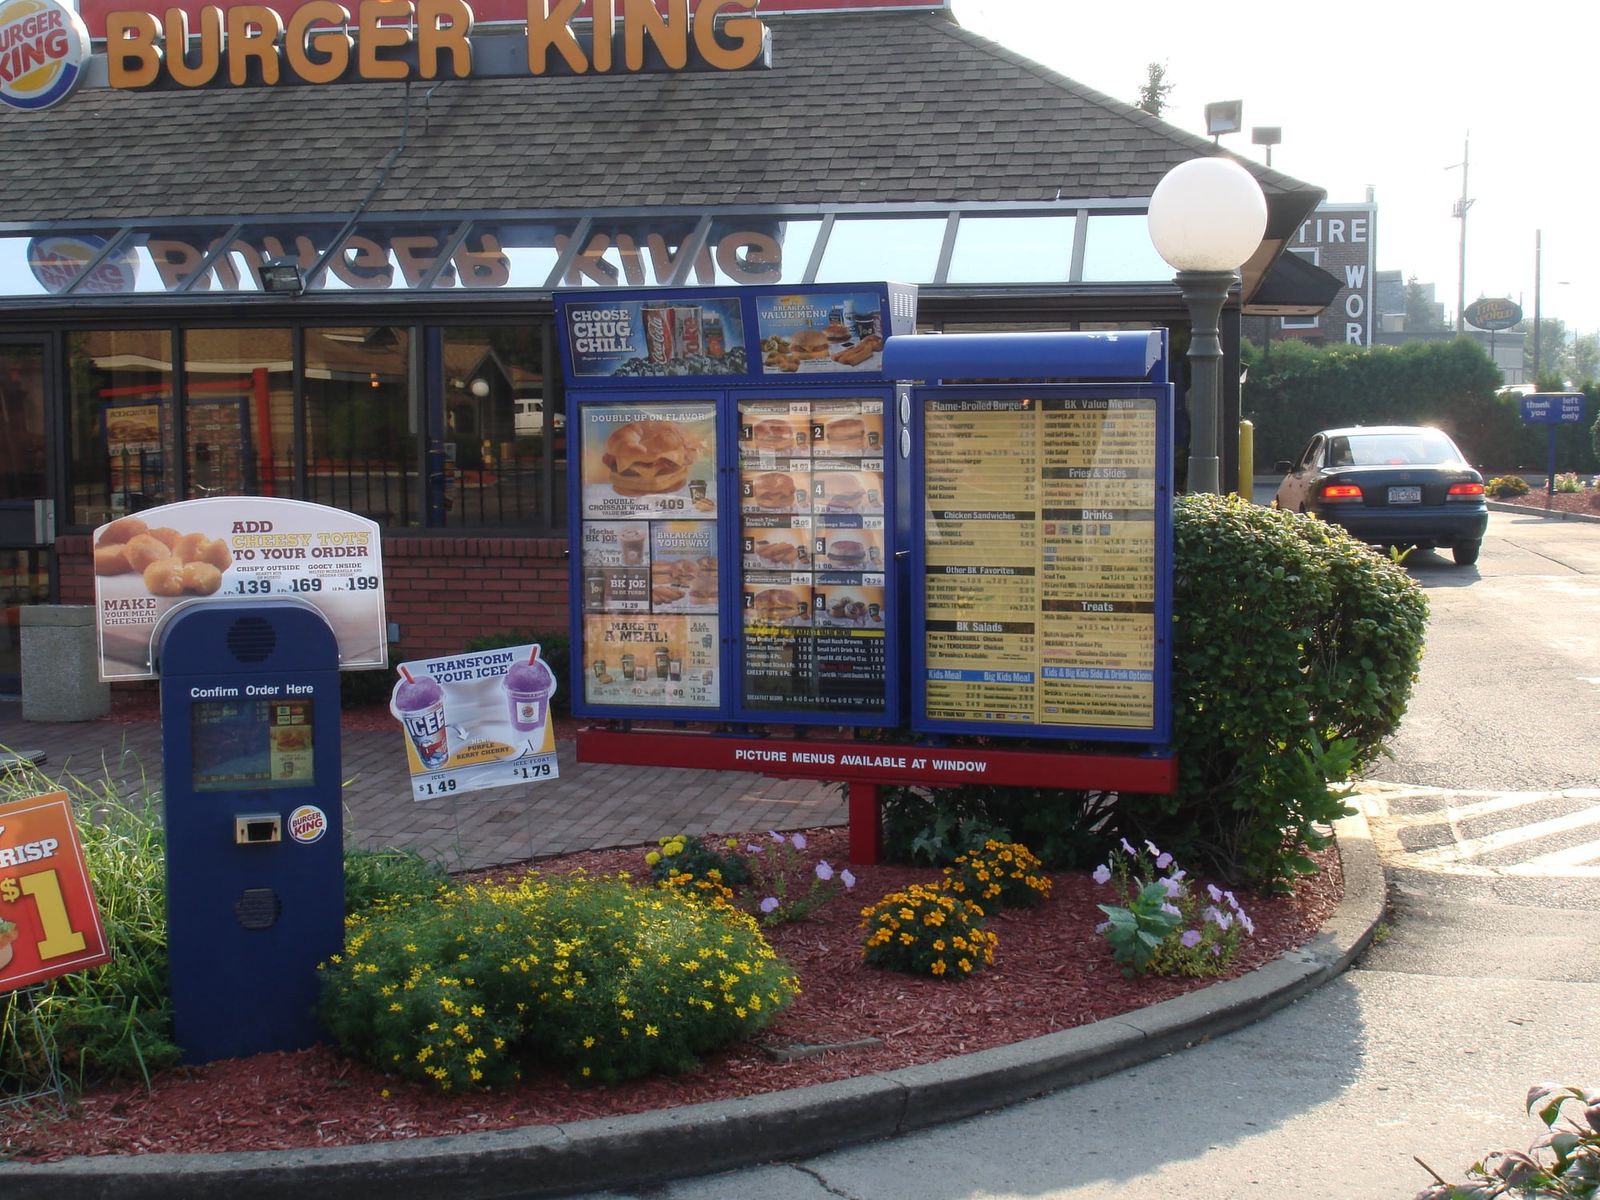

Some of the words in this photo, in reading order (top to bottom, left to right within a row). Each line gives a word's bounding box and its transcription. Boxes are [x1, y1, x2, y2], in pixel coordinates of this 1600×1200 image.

[0, 11, 63, 52] URGER
[106, 0, 472, 88] BURGER
[528, 0, 764, 75] KING
[0, 28, 69, 82] KING
[1300, 219, 1367, 243] TIRE
[572, 309, 632, 322] CHOOSE.
[761, 311, 795, 319] VALUE
[798, 310, 828, 318] MENU
[573, 321, 634, 338] CHUG.
[575, 337, 636, 354] CHILL.
[932, 401, 991, 411] Flame-Broiled
[993, 401, 1029, 411] Burgers
[1064, 400, 1076, 409] BK
[1082, 400, 1107, 409] Value
[1108, 400, 1134, 409] Menu
[1526, 401, 1550, 409] thank
[592, 414, 631, 422] DOUBLE
[666, 413, 705, 421] FLAVOR
[1530, 410, 1546, 418] you
[1561, 412, 1579, 421] only
[745, 428, 750, 438] 1
[814, 427, 821, 438] 2
[1069, 468, 1091, 477] Fries
[1093, 469, 1101, 477] &
[1103, 469, 1127, 478] Sides
[744, 484, 750, 494] 3
[815, 485, 822, 494] 4
[973, 512, 1016, 520] Sandwiches
[1082, 510, 1113, 520] Drinks
[232, 520, 273, 534] ADD
[231, 532, 311, 548] CHEESY
[318, 532, 369, 545] TOTS
[602, 535, 618, 543] JOE
[659, 539, 687, 547] YOUR
[688, 539, 710, 547] WAY
[745, 541, 751, 551] 5
[816, 541, 823, 551] 6
[233, 549, 255, 560] TO
[262, 548, 308, 559] YOUR
[311, 546, 369, 558] ORDER
[946, 566, 966, 574] Other
[610, 580, 626, 588] BK
[629, 580, 646, 589] JOE
[104, 598, 156, 611] MAKE
[745, 596, 751, 606] 7
[816, 597, 823, 607] 8
[1081, 602, 1114, 612] Treats
[104, 617, 157, 626] CHEESIER!
[611, 623, 645, 631] MAKE
[648, 623, 659, 631] IT
[956, 622, 969, 631] BK
[972, 622, 1003, 632] Salads
[604, 631, 616, 642] A
[620, 631, 669, 643] MEAL!
[427, 652, 514, 674] TRANSFORM
[433, 670, 473, 685] YOUR
[476, 665, 508, 678] ICEE
[928, 670, 944, 679] Kids
[944, 671, 962, 679] Meal
[984, 672, 996, 682] Big
[996, 672, 1012, 681] Kids
[1012, 673, 1031, 682] Meal
[1045, 668, 1058, 677] Kids
[1060, 668, 1065, 677] &
[1065, 669, 1075, 679] Big
[1076, 669, 1090, 678] Kids
[1090, 669, 1103, 679] Side
[1111, 670, 1128, 680] Drink
[1129, 671, 1152, 681] Options
[190, 686, 239, 698] Confirm
[245, 684, 280, 696] Order
[286, 684, 314, 694] Here
[405, 707, 446, 738] ICEE
[467, 742, 495, 751] PURPLE
[456, 752, 479, 760] BERRY
[481, 747, 509, 756] CHERRY
[735, 750, 787, 762] PICTURE
[792, 752, 836, 765] MENUS
[840, 754, 906, 768] AVAILABLE
[911, 758, 927, 769] AT
[932, 760, 987, 772] WINDOW
[292, 811, 321, 828] BURGER
[293, 818, 323, 838] KING
[0, 837, 58, 868] RISP
[0, 869, 86, 961] $1
